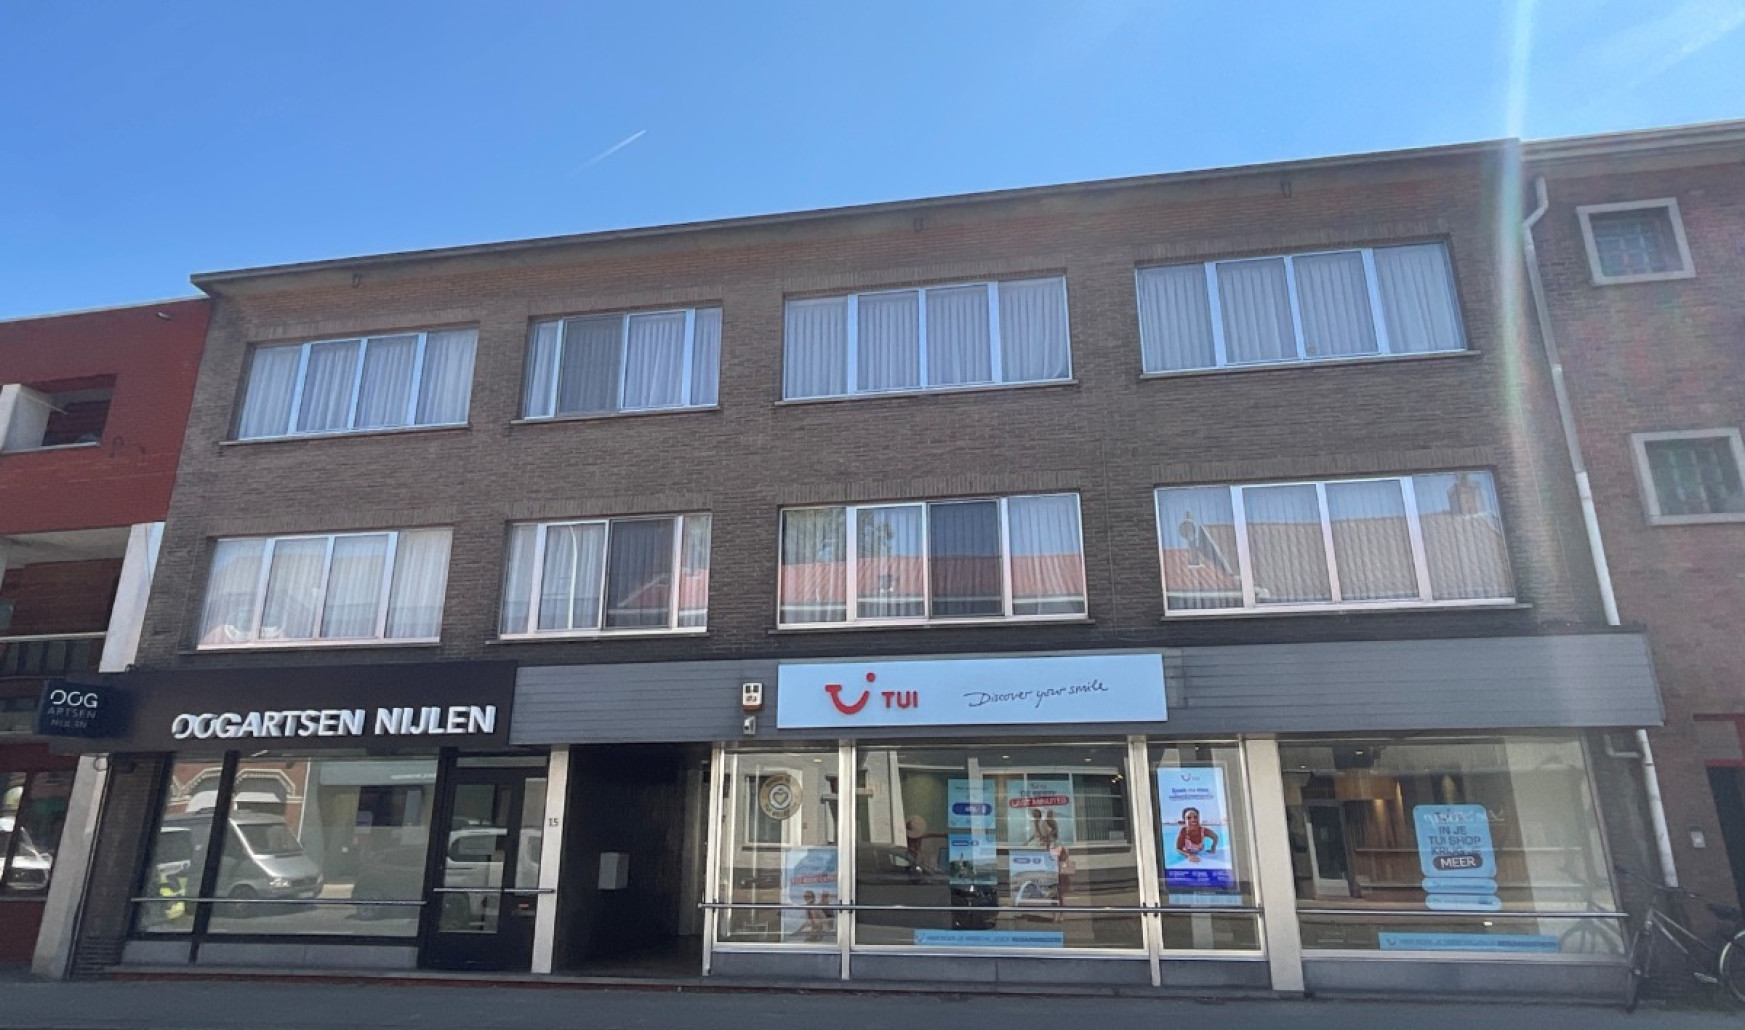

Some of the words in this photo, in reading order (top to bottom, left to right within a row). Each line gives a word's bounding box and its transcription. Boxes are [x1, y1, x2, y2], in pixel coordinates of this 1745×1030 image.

[50, 689, 98, 708] OOG
[881, 691, 919, 709] TUI
[963, 690, 1033, 708] Discover
[1036, 686, 1066, 709] your
[1068, 679, 1109, 696] smile
[171, 709, 365, 739] OOGARTSEN
[374, 704, 497, 735] NIJLEN
[1440, 857, 1476, 868] MEER
